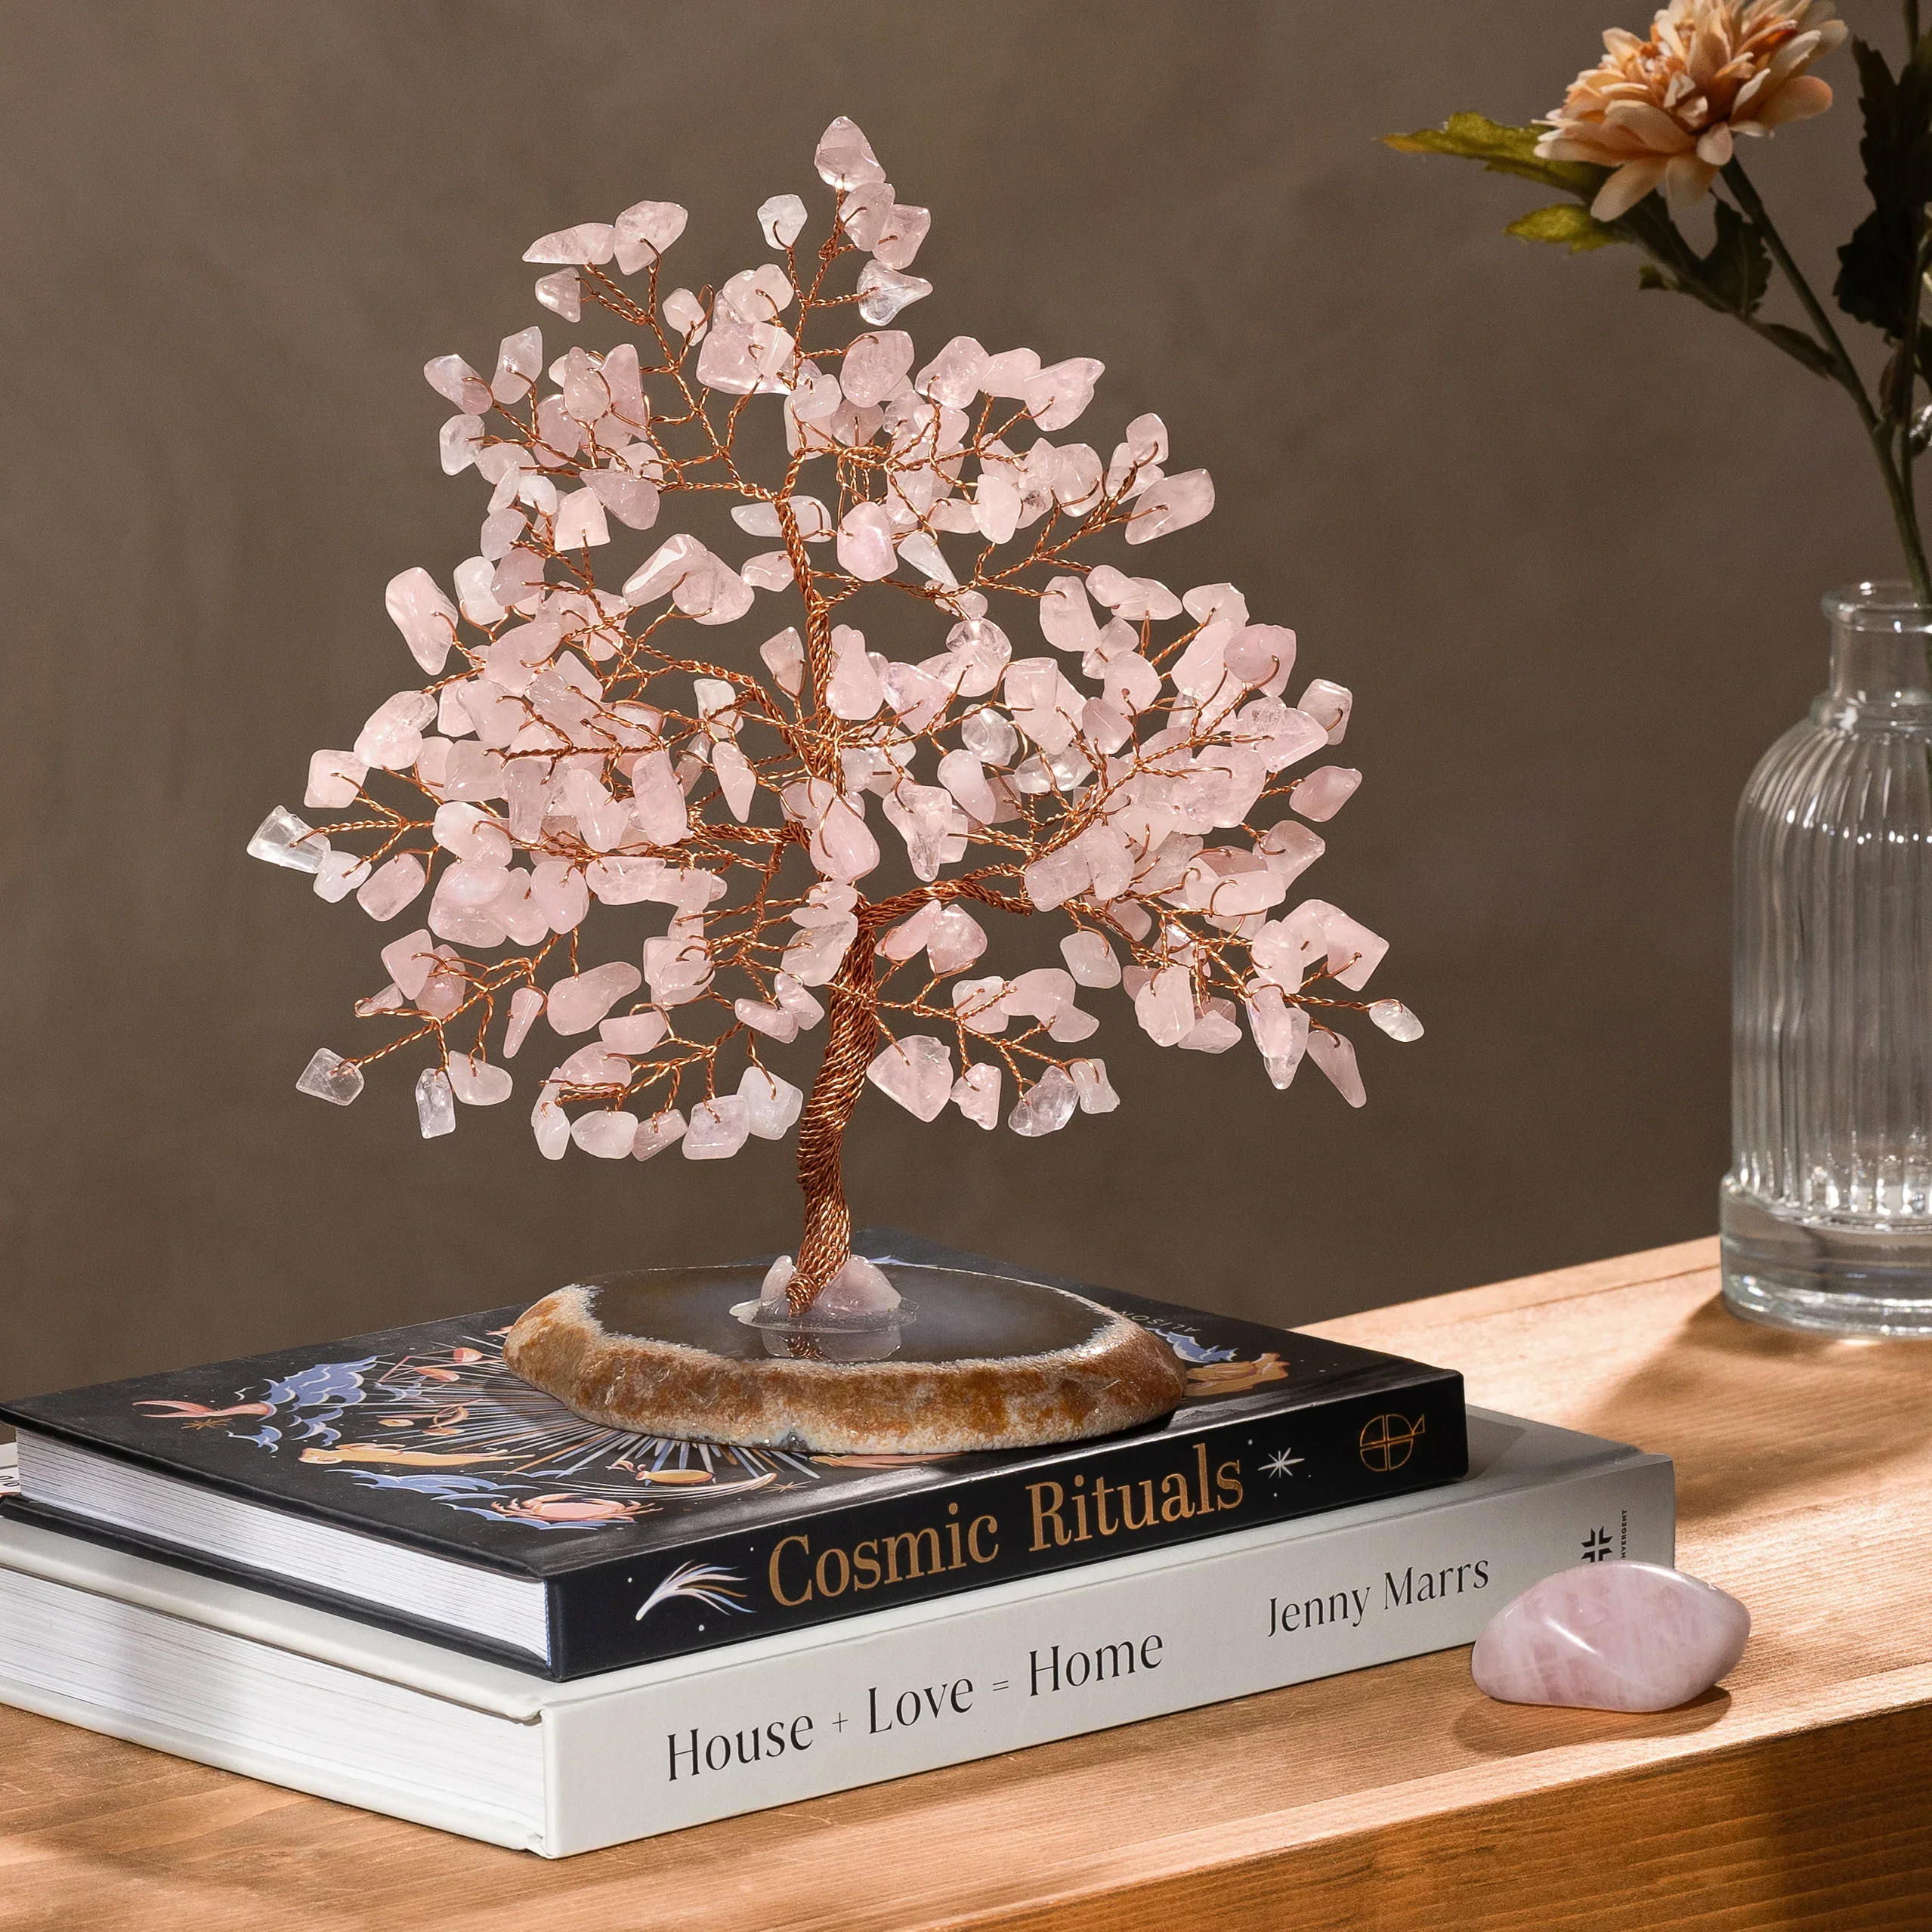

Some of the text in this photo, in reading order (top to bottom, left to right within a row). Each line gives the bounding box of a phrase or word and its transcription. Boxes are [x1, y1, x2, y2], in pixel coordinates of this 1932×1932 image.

[769, 1442, 1244, 1607] Cosmic Rituals
[1268, 1559, 1489, 1637] Jenny Marrs
[666, 1634, 1164, 1782] House + Love = Home
